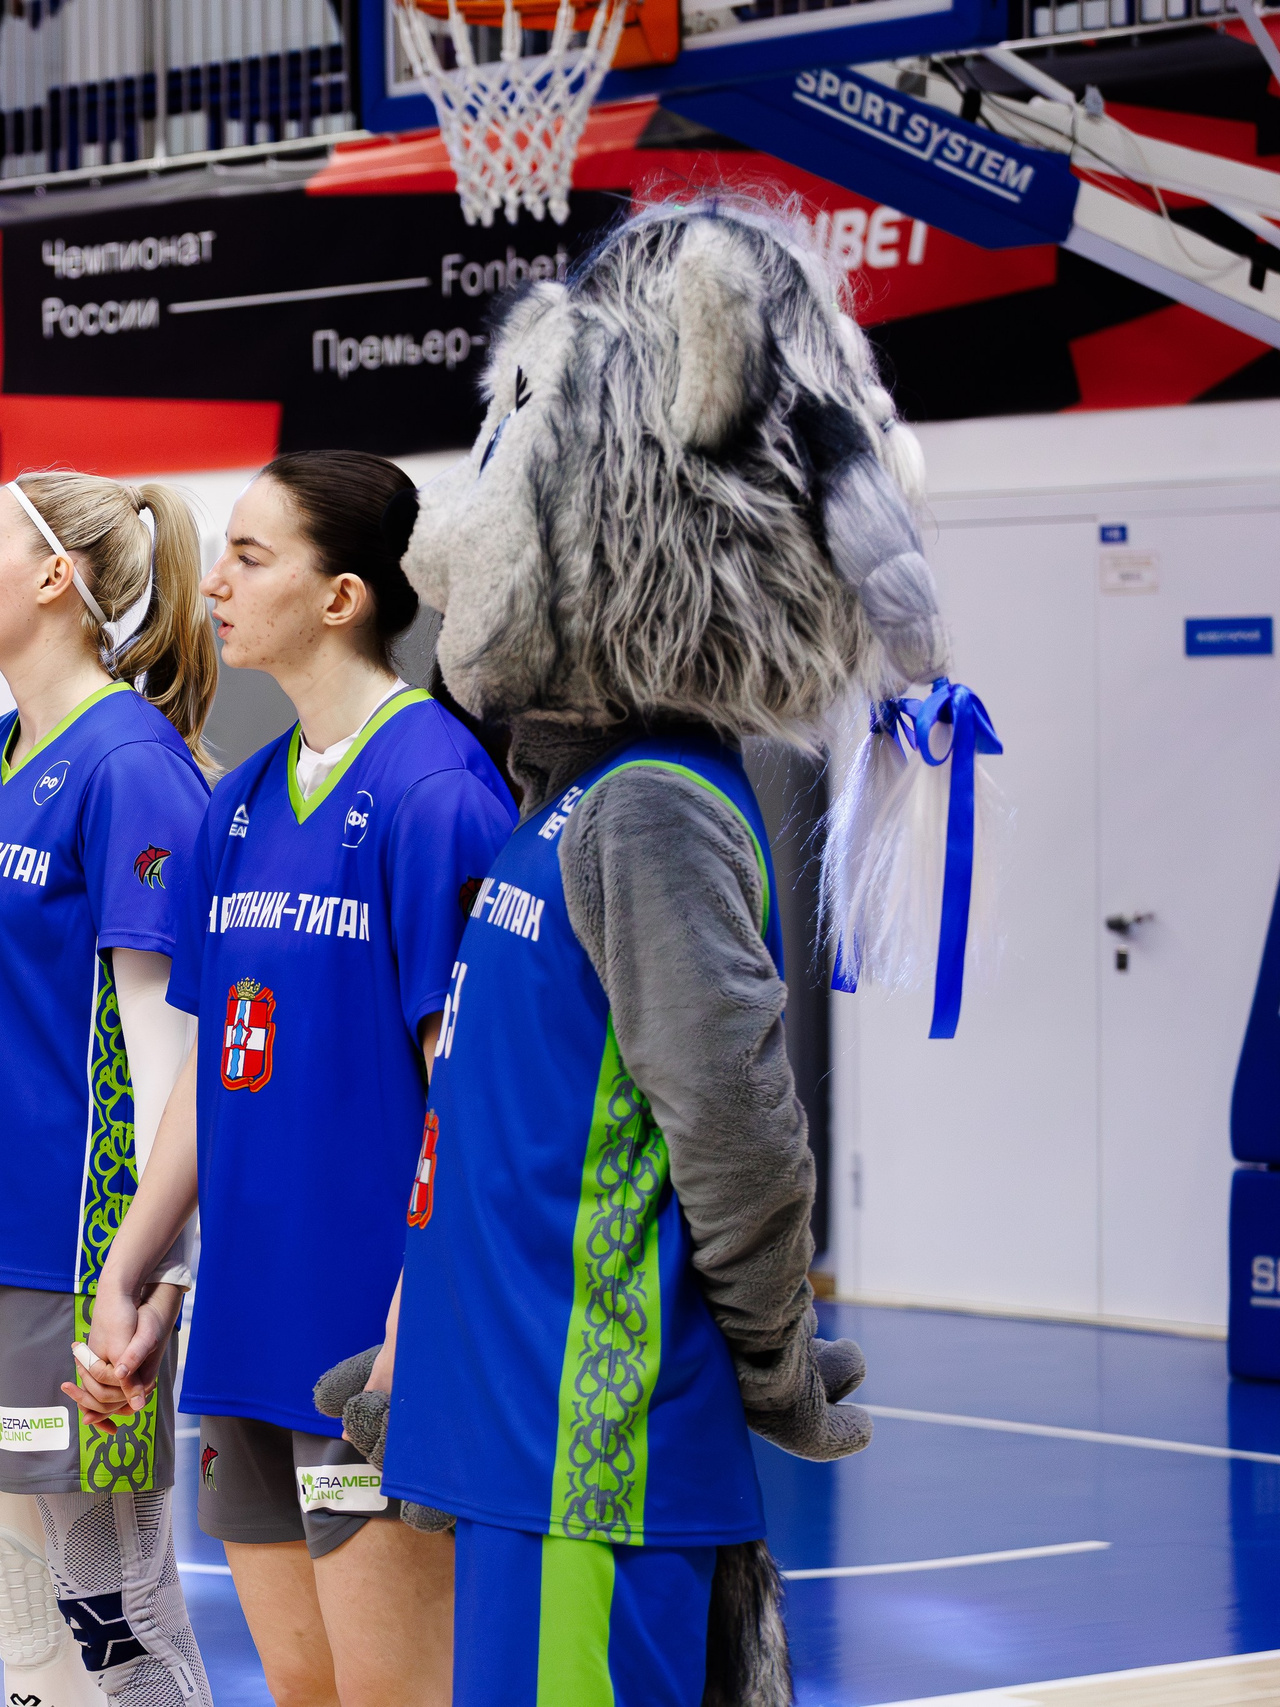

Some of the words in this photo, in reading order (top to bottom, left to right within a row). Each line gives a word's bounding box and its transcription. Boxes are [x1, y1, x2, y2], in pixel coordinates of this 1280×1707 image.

[795, 70, 906, 135] SPORT
[904, 114, 1035, 195] SYSTEM
[42, 229, 217, 281] Чемпионат
[42, 295, 160, 339] России
[2, 1417, 64, 1430] EZRAMED
[4, 1430, 33, 1442] CLINIC
